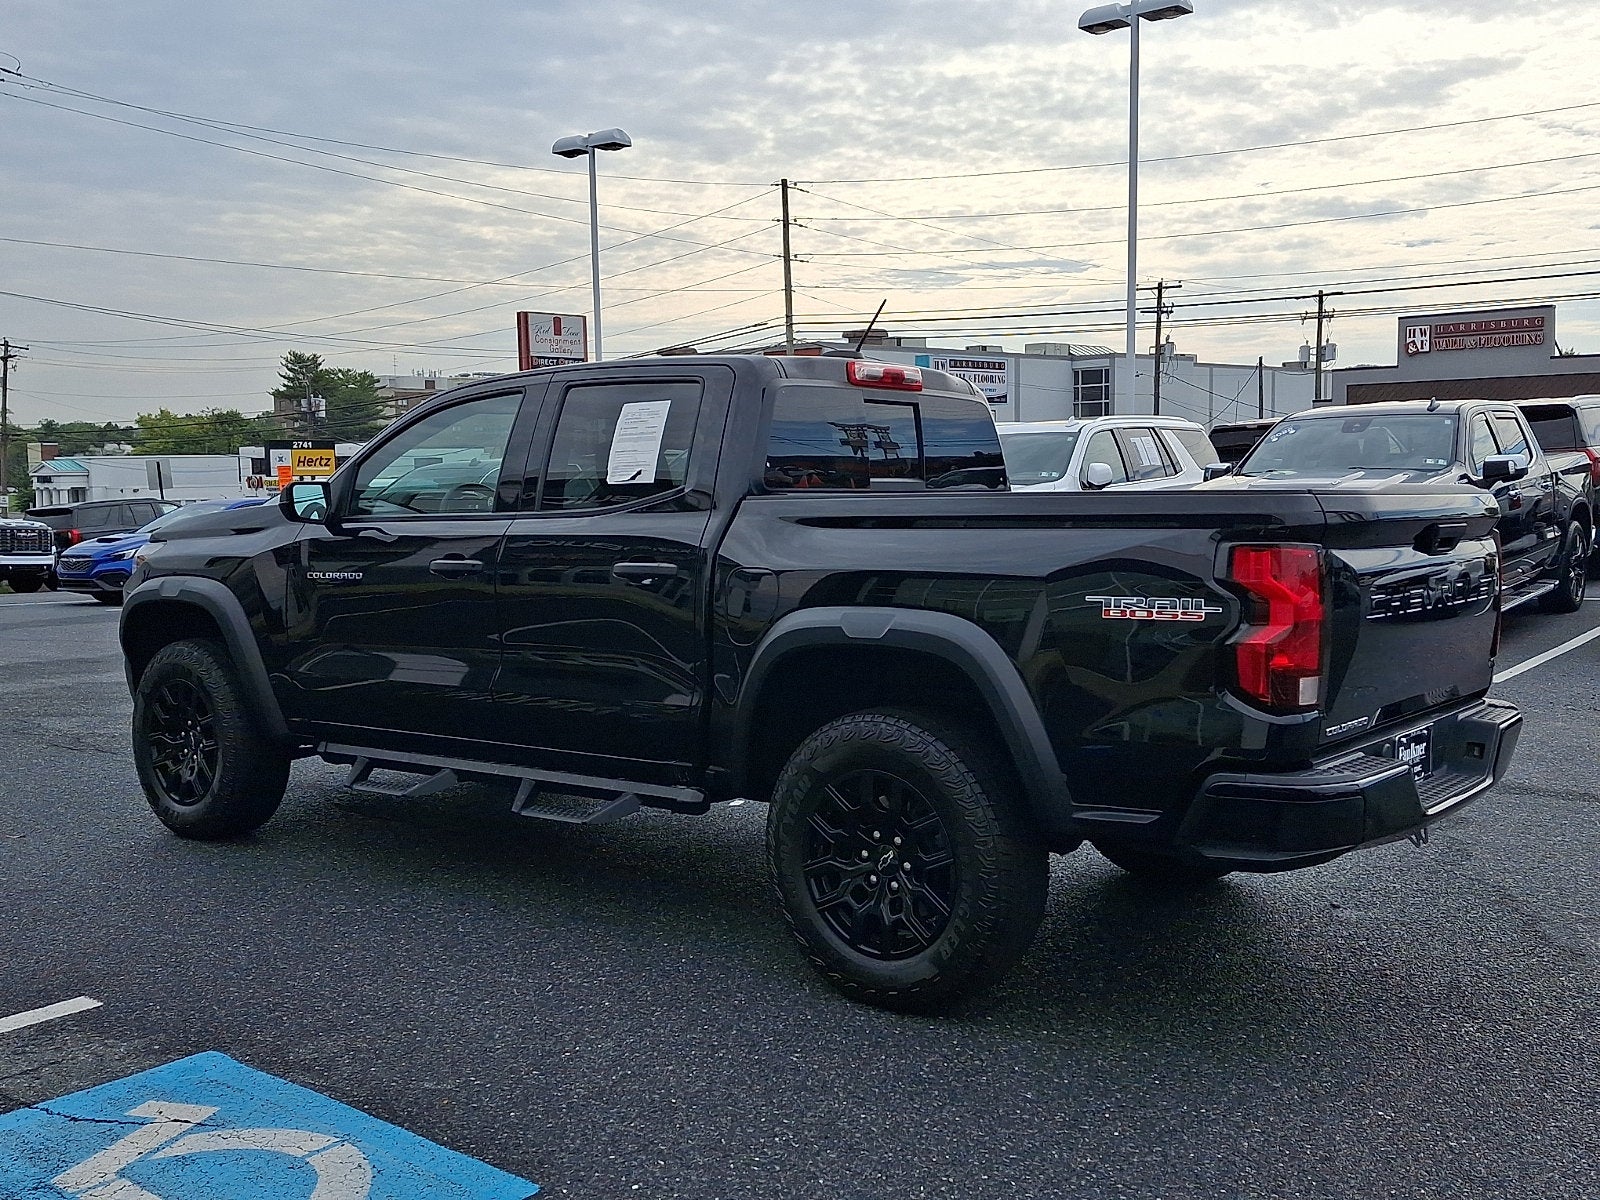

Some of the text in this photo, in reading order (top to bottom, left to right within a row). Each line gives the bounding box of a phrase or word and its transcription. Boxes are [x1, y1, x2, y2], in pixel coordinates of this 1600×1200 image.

[1437, 318, 1542, 333] HARRISBURG
[534, 333, 581, 347] Consignment
[1433, 337, 1464, 351] WALL
[1477, 331, 1544, 348] FLOORING
[549, 344, 573, 356] Gallery
[533, 357, 557, 365] DIRECT
[950, 360, 1005, 369] HARRISBURG
[973, 373, 1006, 384] FLOORING
[292, 441, 313, 449] 2741
[296, 455, 332, 468] Hertz
[306, 571, 363, 580] COLORADO
[1085, 595, 1223, 613] TRAIL
[1101, 607, 1206, 622] BOSS
[1398, 742, 1427, 761] Faulkner
